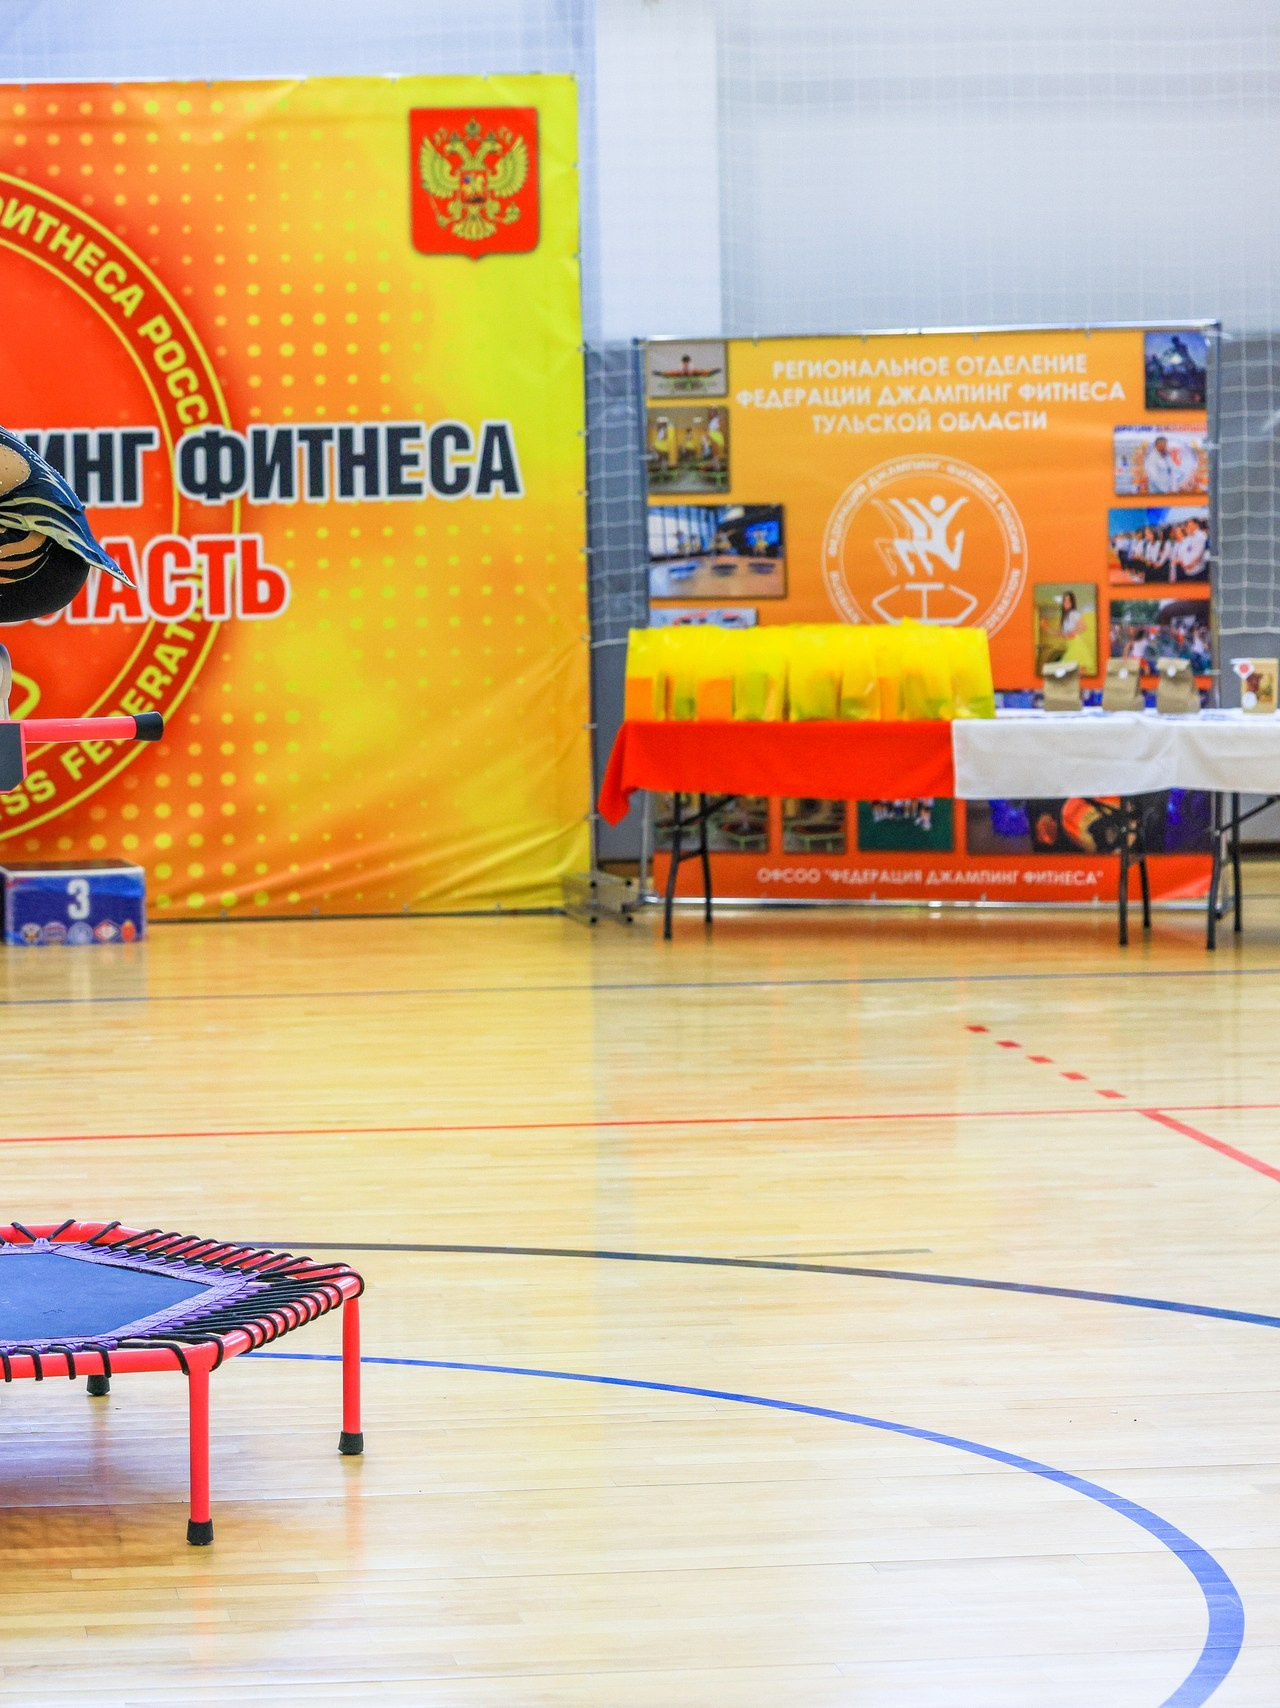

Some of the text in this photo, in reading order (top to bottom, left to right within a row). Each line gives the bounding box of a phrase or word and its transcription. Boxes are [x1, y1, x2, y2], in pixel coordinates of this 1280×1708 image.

[137, 313, 212, 432] РОСС
[772, 354, 1087, 381] РЕГИОНАЛЬНОЕ ОТДЕЛЕНИЕ
[736, 380, 1126, 410] ФЕДЕРАЦИИ ДЖАМПИНГ ФИТНЕСА
[813, 408, 1048, 434] ТУЛЬСКОЙ ОБЛАСТИ
[178, 421, 524, 506] ФИТНЕСА
[70, 534, 289, 622] АСТЬ
[66, 878, 89, 920] 3
